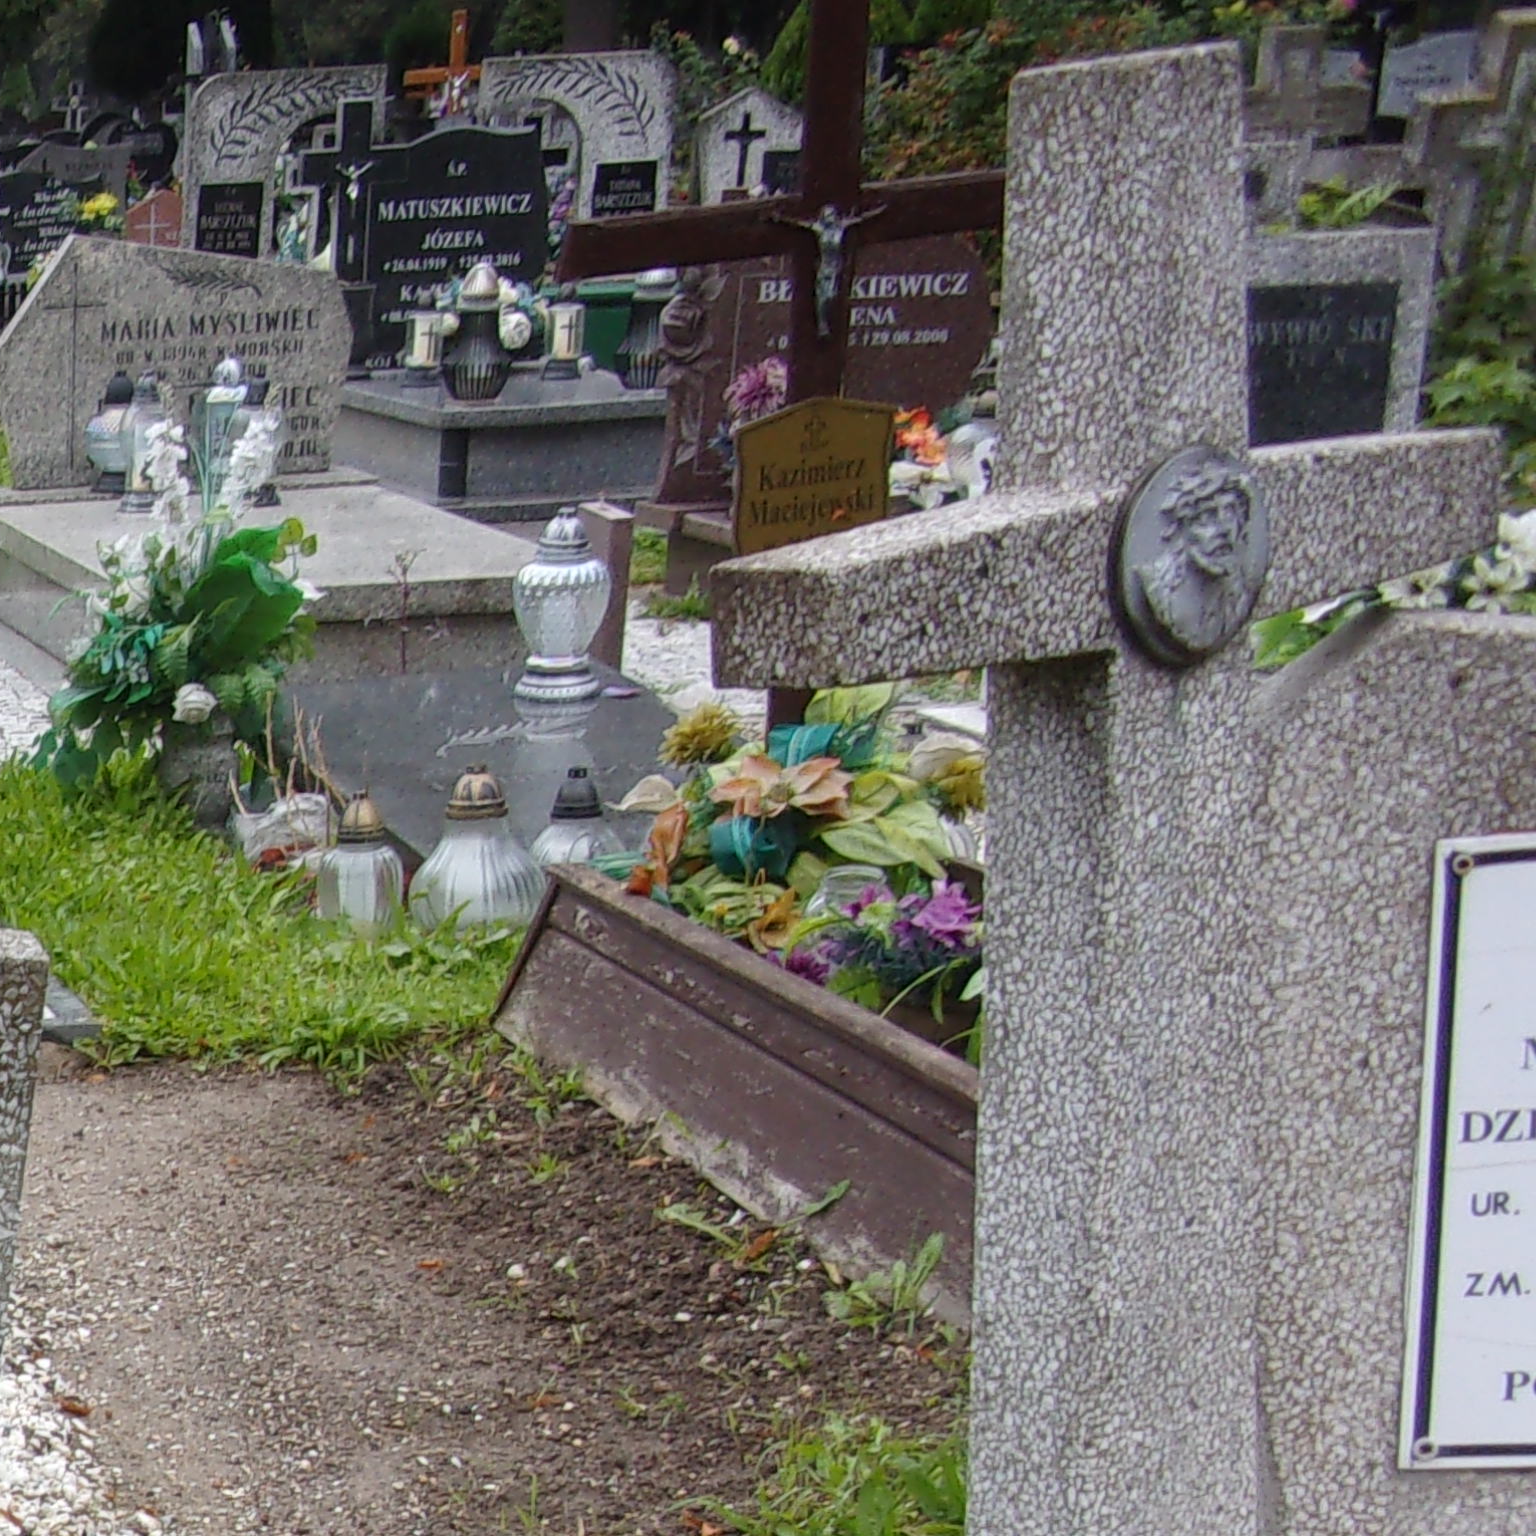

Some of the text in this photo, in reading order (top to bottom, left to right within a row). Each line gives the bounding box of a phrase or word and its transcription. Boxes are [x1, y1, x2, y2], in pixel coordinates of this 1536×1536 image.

[378, 194, 532, 221] MATUSZKIEWICZ
[421, 228, 484, 249] JÓZEFA
[100, 317, 175, 343] MARIA
[759, 456, 865, 491] Kazimierz
[1470, 1191, 1520, 1217] UR.
[1465, 1271, 1530, 1297] ZM.
